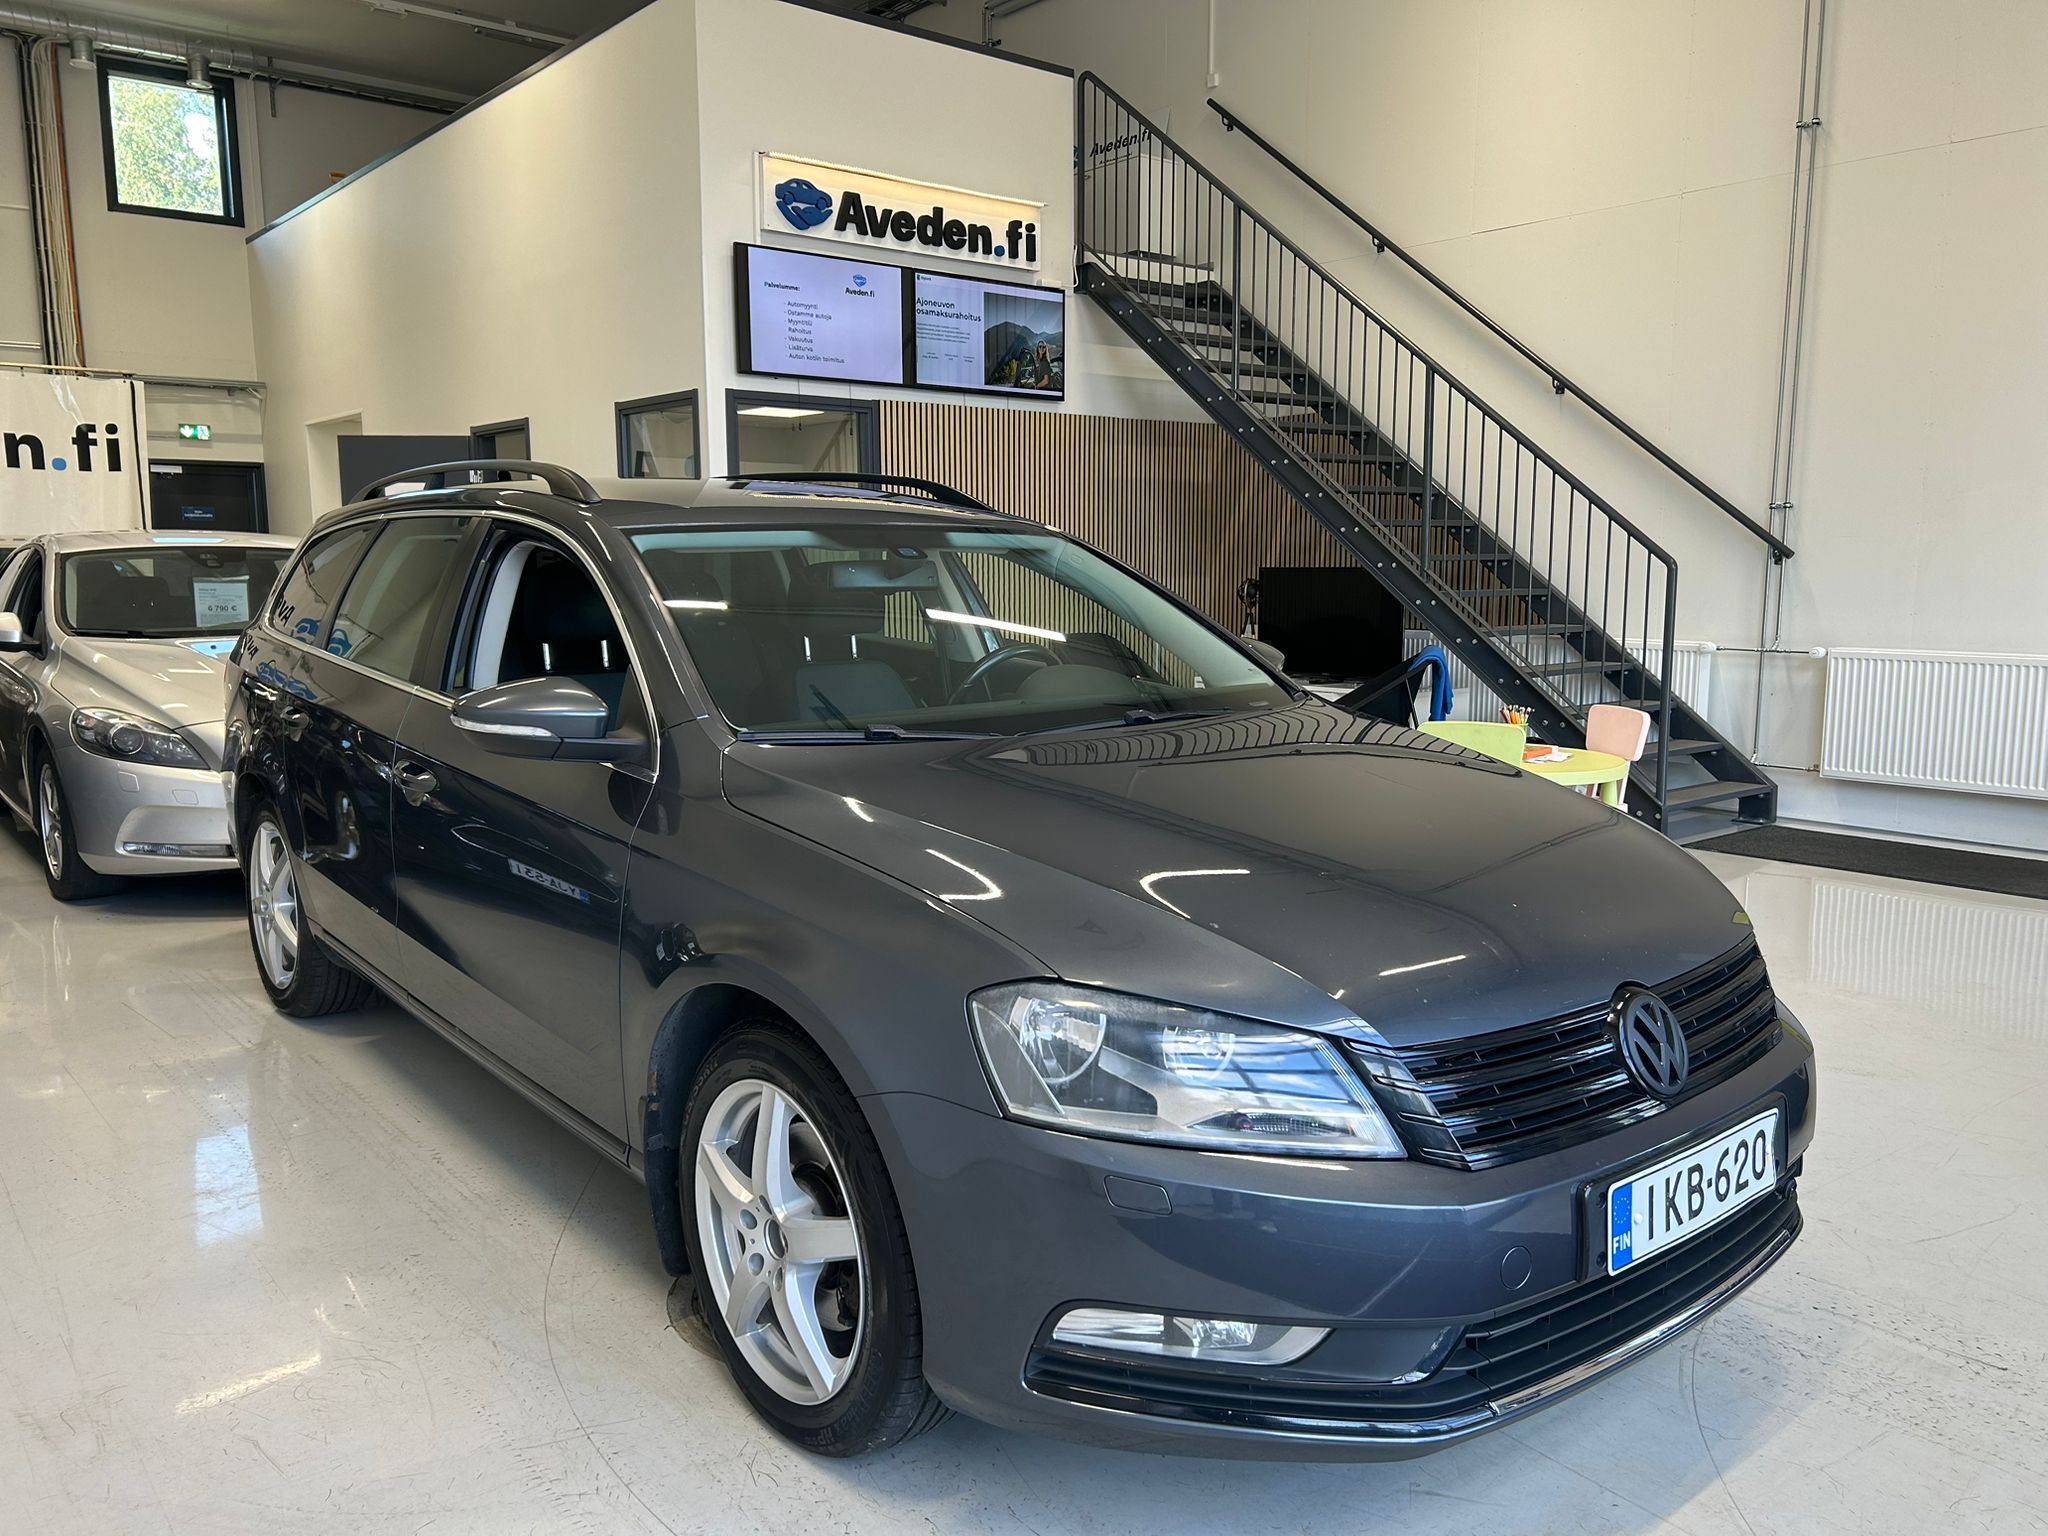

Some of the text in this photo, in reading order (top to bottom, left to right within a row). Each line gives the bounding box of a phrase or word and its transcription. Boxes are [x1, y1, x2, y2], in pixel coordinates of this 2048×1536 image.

[834, 191, 1037, 262] Aveden.fi
[764, 281, 801, 291] Palvelumme:
[845, 287, 875, 298] Aveden.fi
[787, 301, 818, 310] Automyynti
[916, 297, 955, 310] Ajoneuvon
[787, 309, 832, 321] Ostamme autoja
[916, 307, 982, 322] osamaksurahoitus
[788, 326, 812, 335] Rahoitus
[788, 336, 813, 344] Vakuutus
[788, 344, 813, 352] Lisäturva
[788, 353, 845, 364] Auton kotiin toimitus
[1647, 1129, 1767, 1241] IKB-620
[1612, 1230, 1631, 1255] FIN
